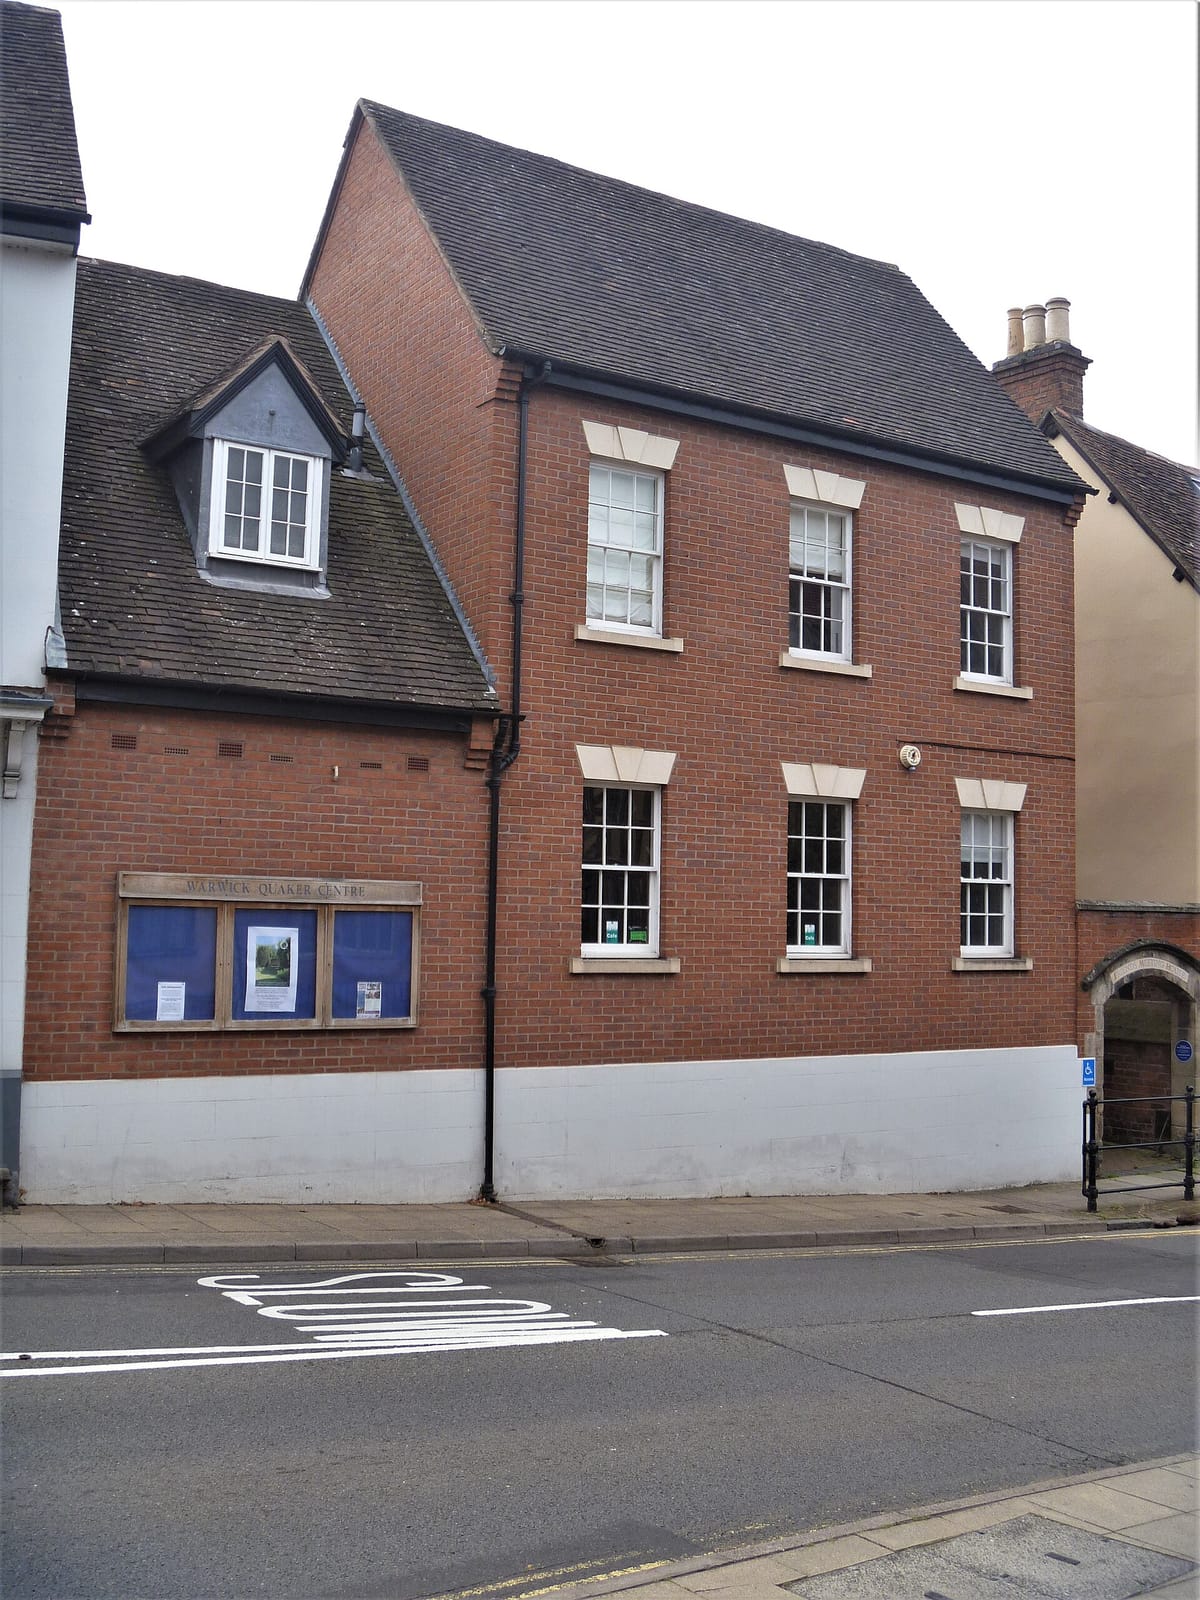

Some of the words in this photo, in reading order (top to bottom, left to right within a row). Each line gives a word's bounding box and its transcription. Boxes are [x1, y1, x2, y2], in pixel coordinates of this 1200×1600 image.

[186, 879, 250, 895] WARWICK
[258, 882, 312, 896] QUAKER
[317, 884, 366, 897] CENTRE
